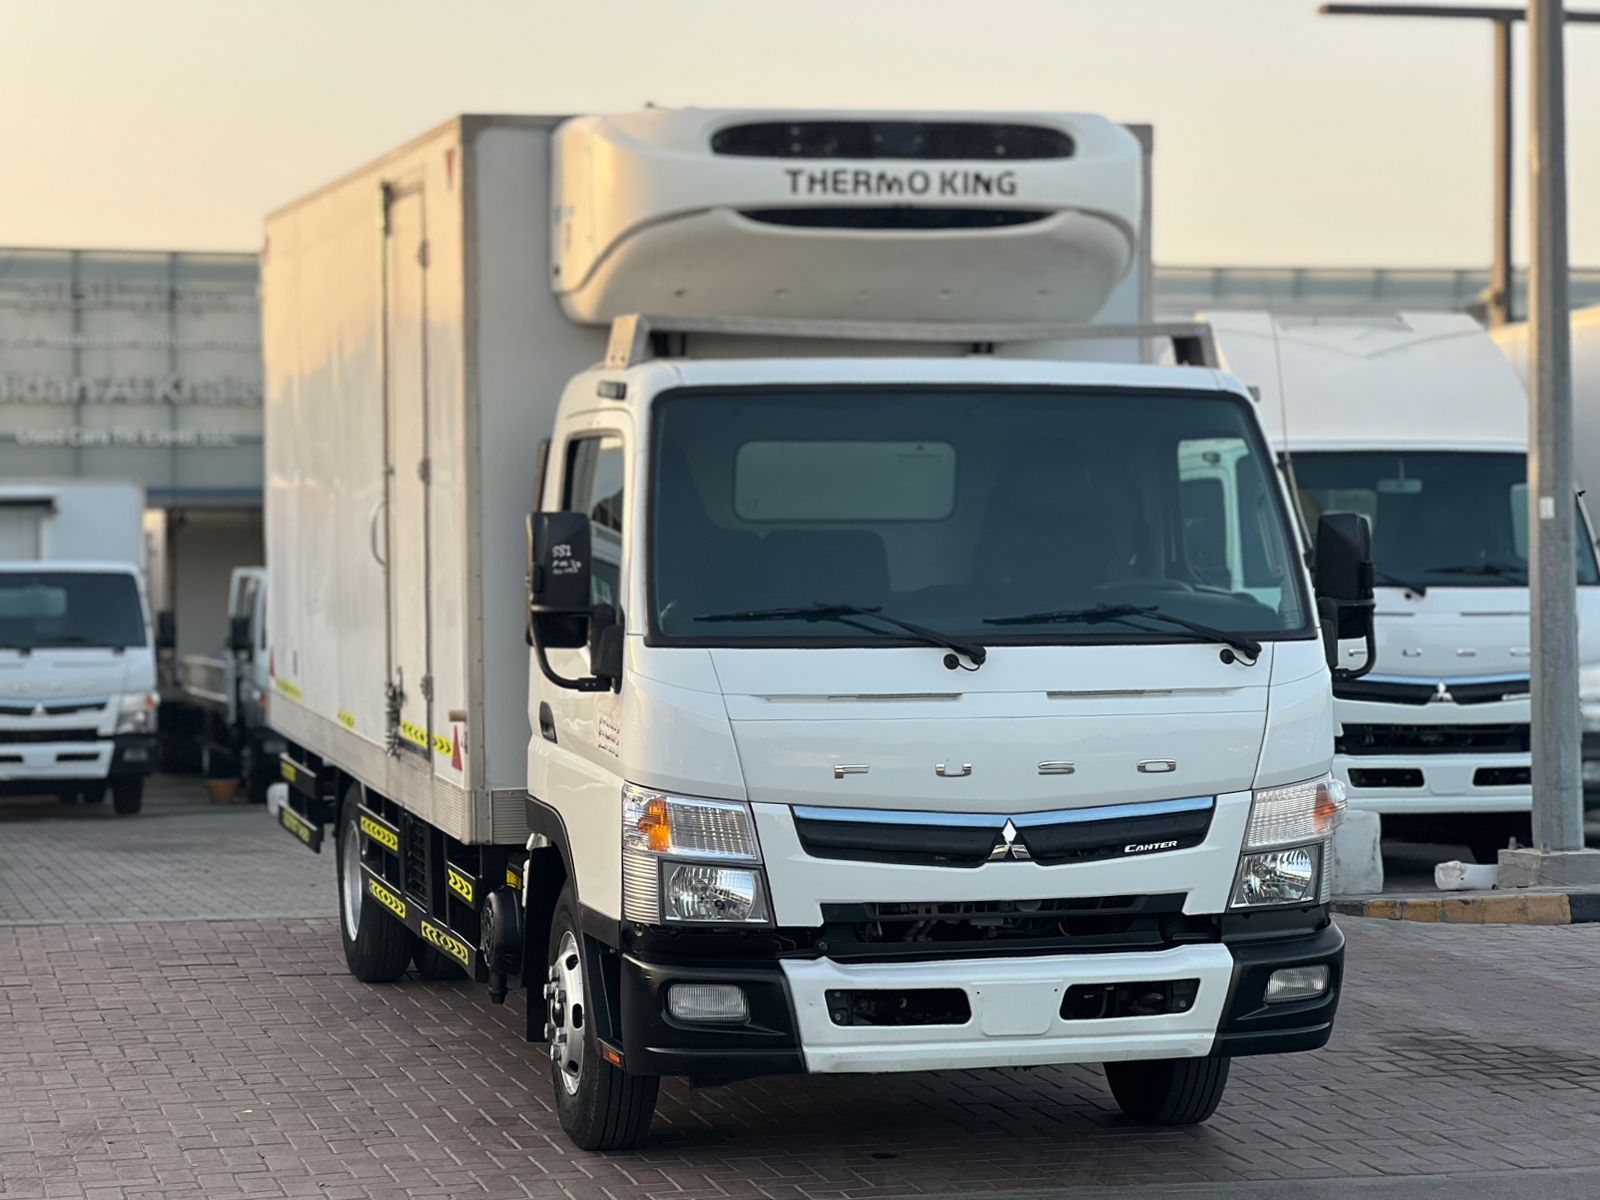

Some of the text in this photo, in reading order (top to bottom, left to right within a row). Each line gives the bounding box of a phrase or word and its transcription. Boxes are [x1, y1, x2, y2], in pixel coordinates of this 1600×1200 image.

[785, 169, 1017, 195] THERMO KING
[834, 757, 1177, 779] FUSO
[1124, 840, 1178, 853] CANTER
